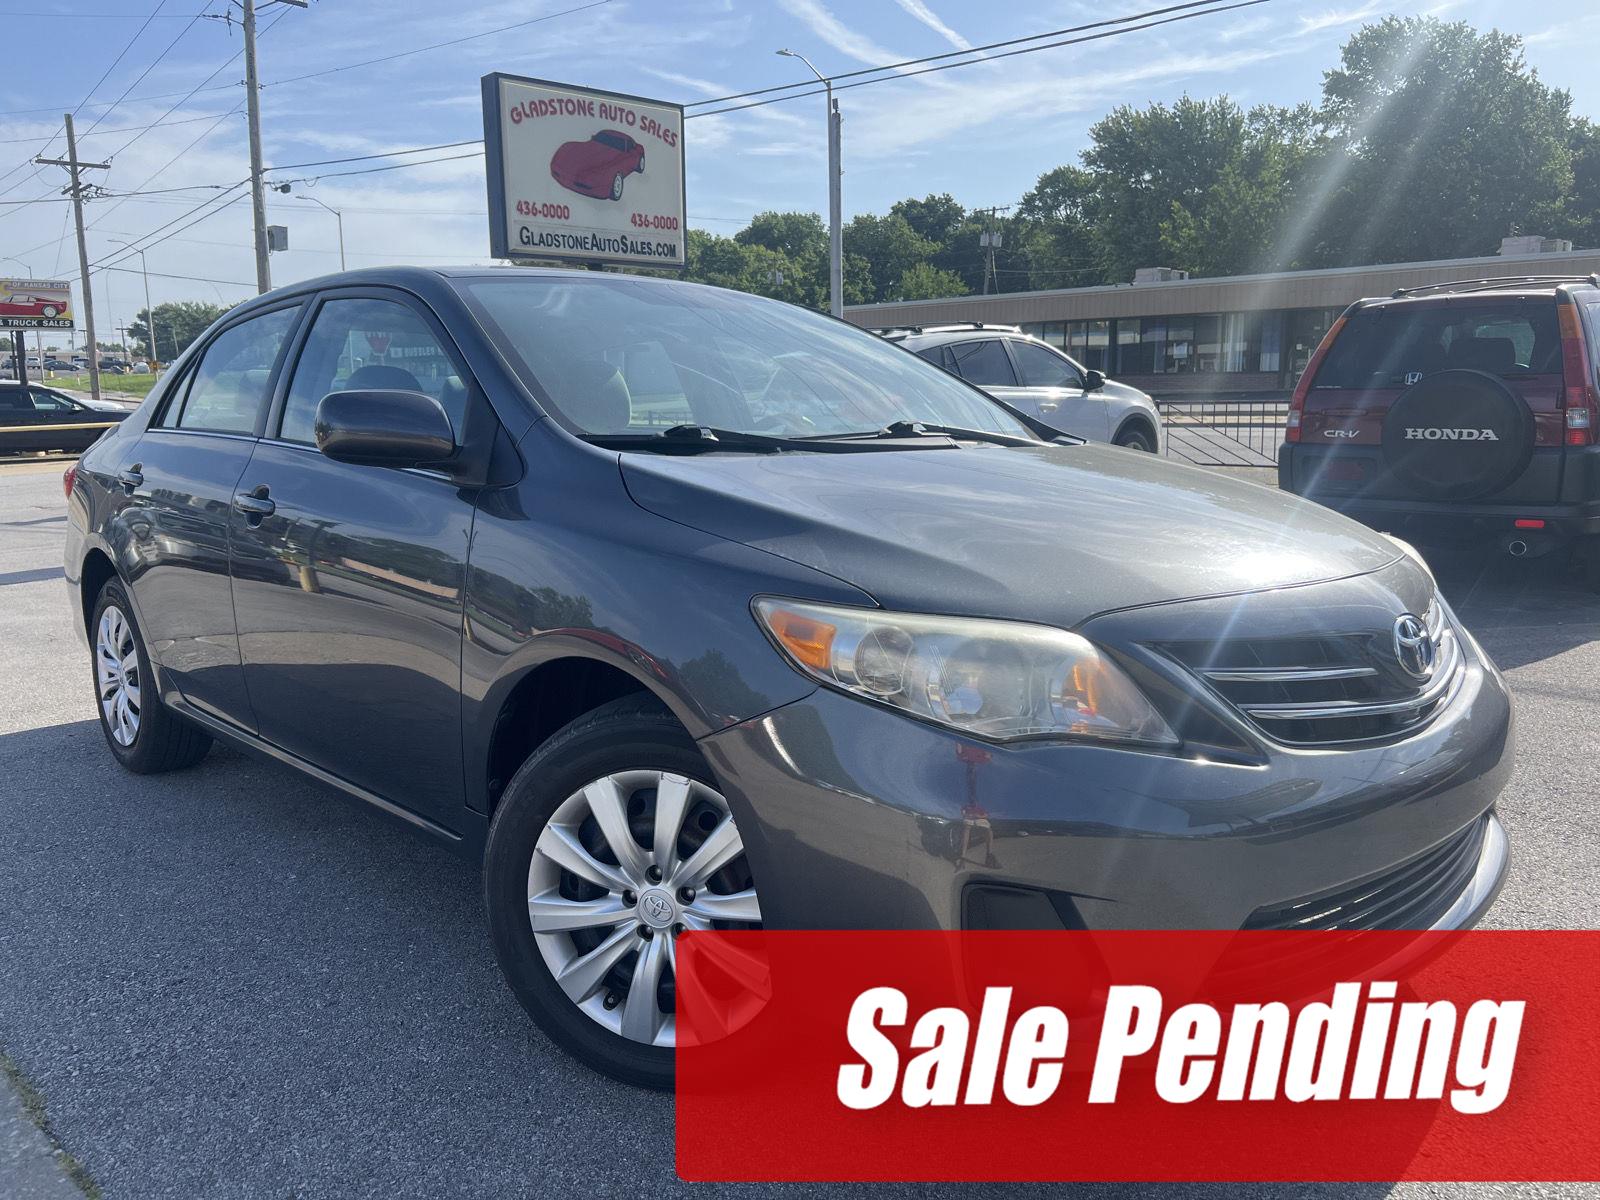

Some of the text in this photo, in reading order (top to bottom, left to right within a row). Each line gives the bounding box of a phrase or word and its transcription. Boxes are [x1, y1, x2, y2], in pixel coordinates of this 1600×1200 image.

[511, 98, 678, 148] GLADSTONE AUTO SALES
[516, 200, 570, 220] 436-0000
[630, 213, 678, 230] 436-0000
[1324, 429, 1360, 438] CR-V
[1405, 428, 1499, 441] HONDA
